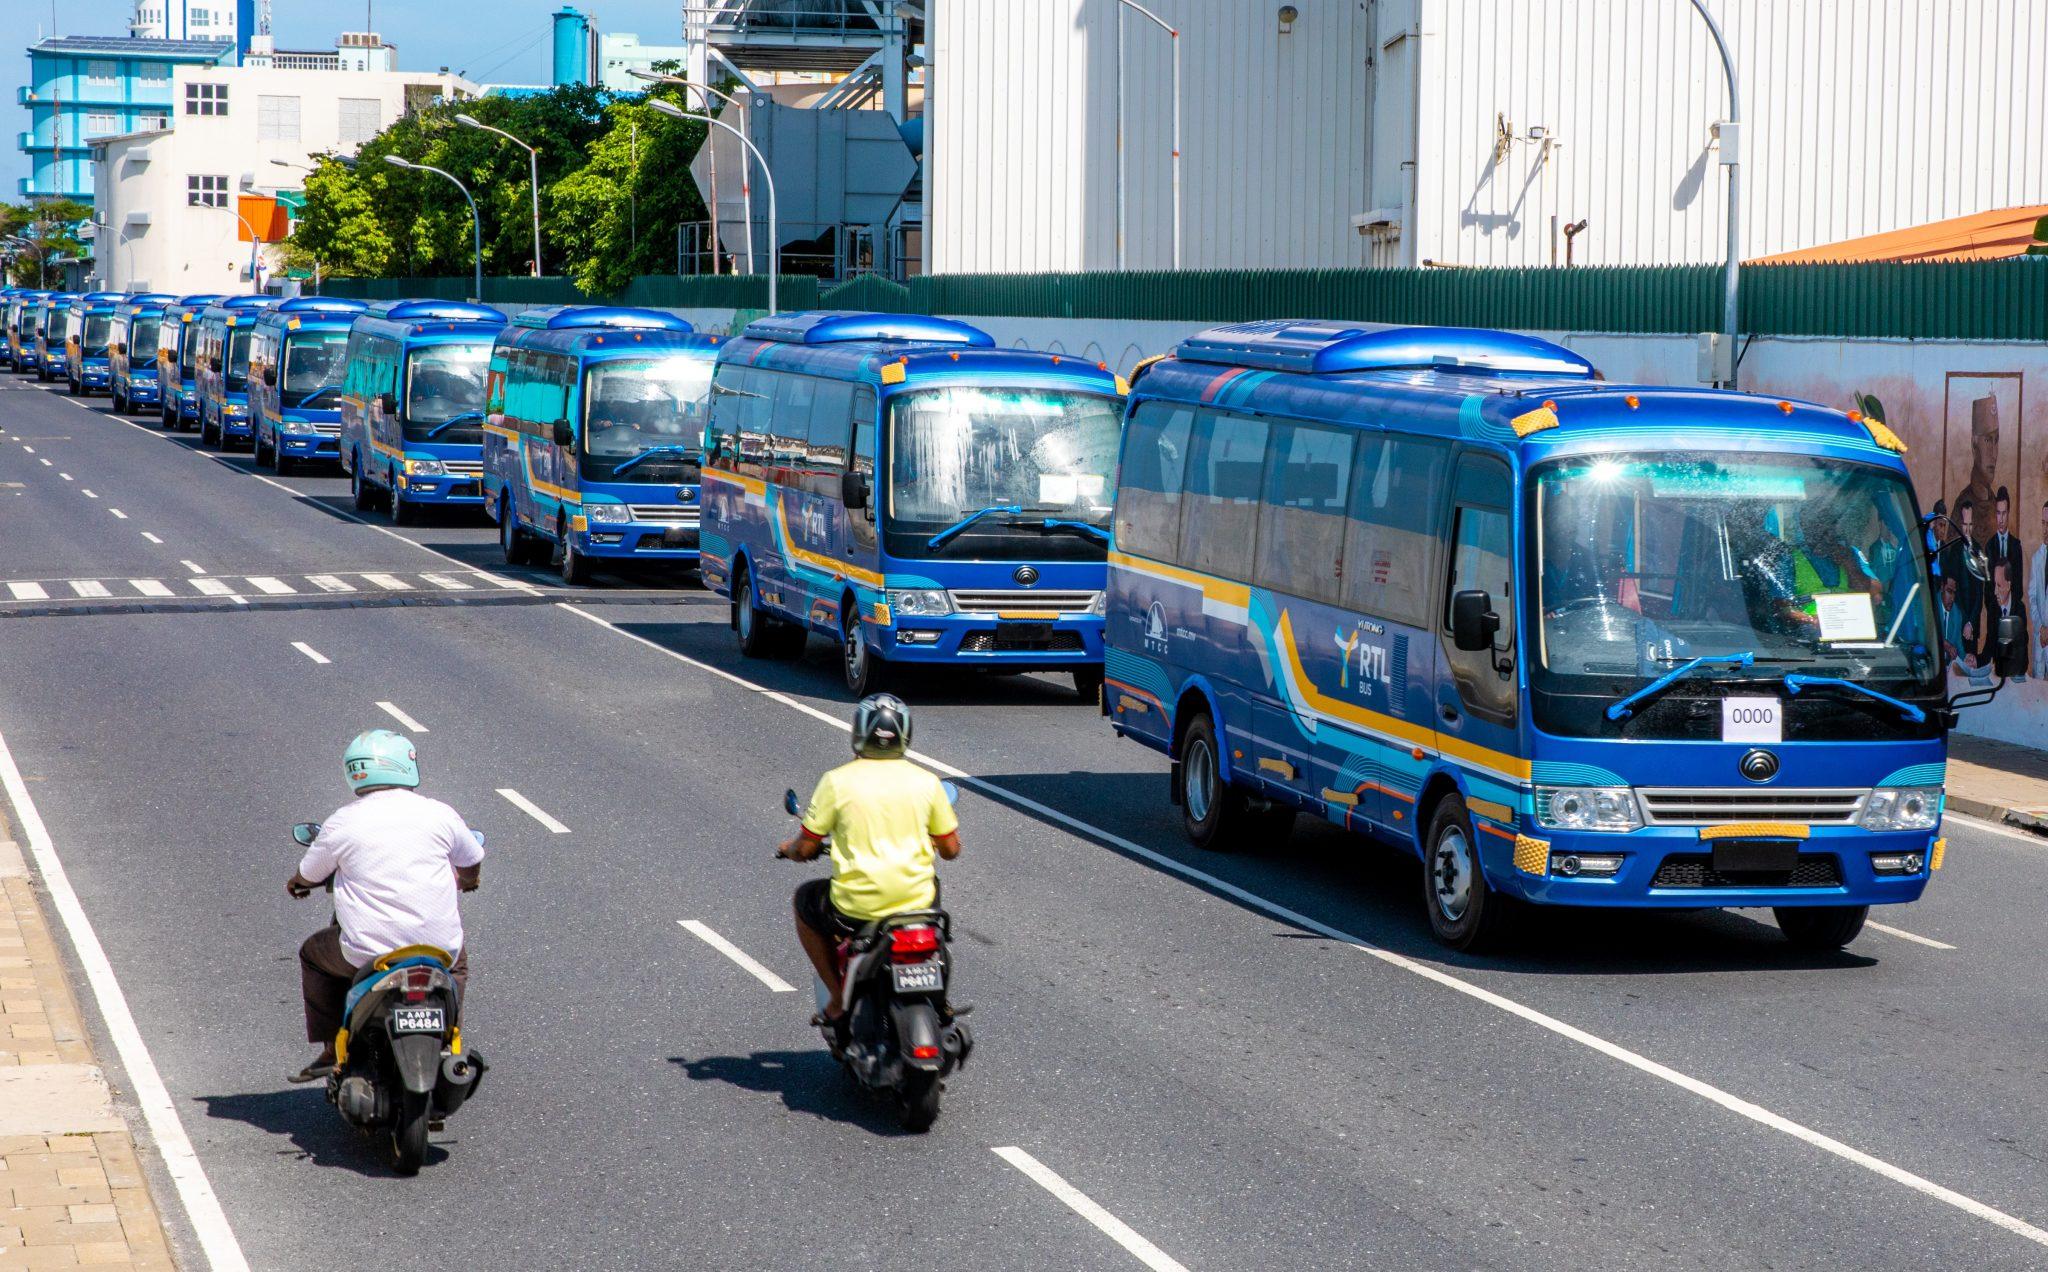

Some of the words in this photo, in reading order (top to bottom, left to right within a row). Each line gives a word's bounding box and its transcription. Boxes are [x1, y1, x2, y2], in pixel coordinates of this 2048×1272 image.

[1144, 638, 1168, 655] MTCC
[1359, 643, 1391, 684] RTL
[1359, 681, 1372, 696] BUS
[1732, 708, 1773, 724] 0000
[399, 1018, 440, 1029] P6484
